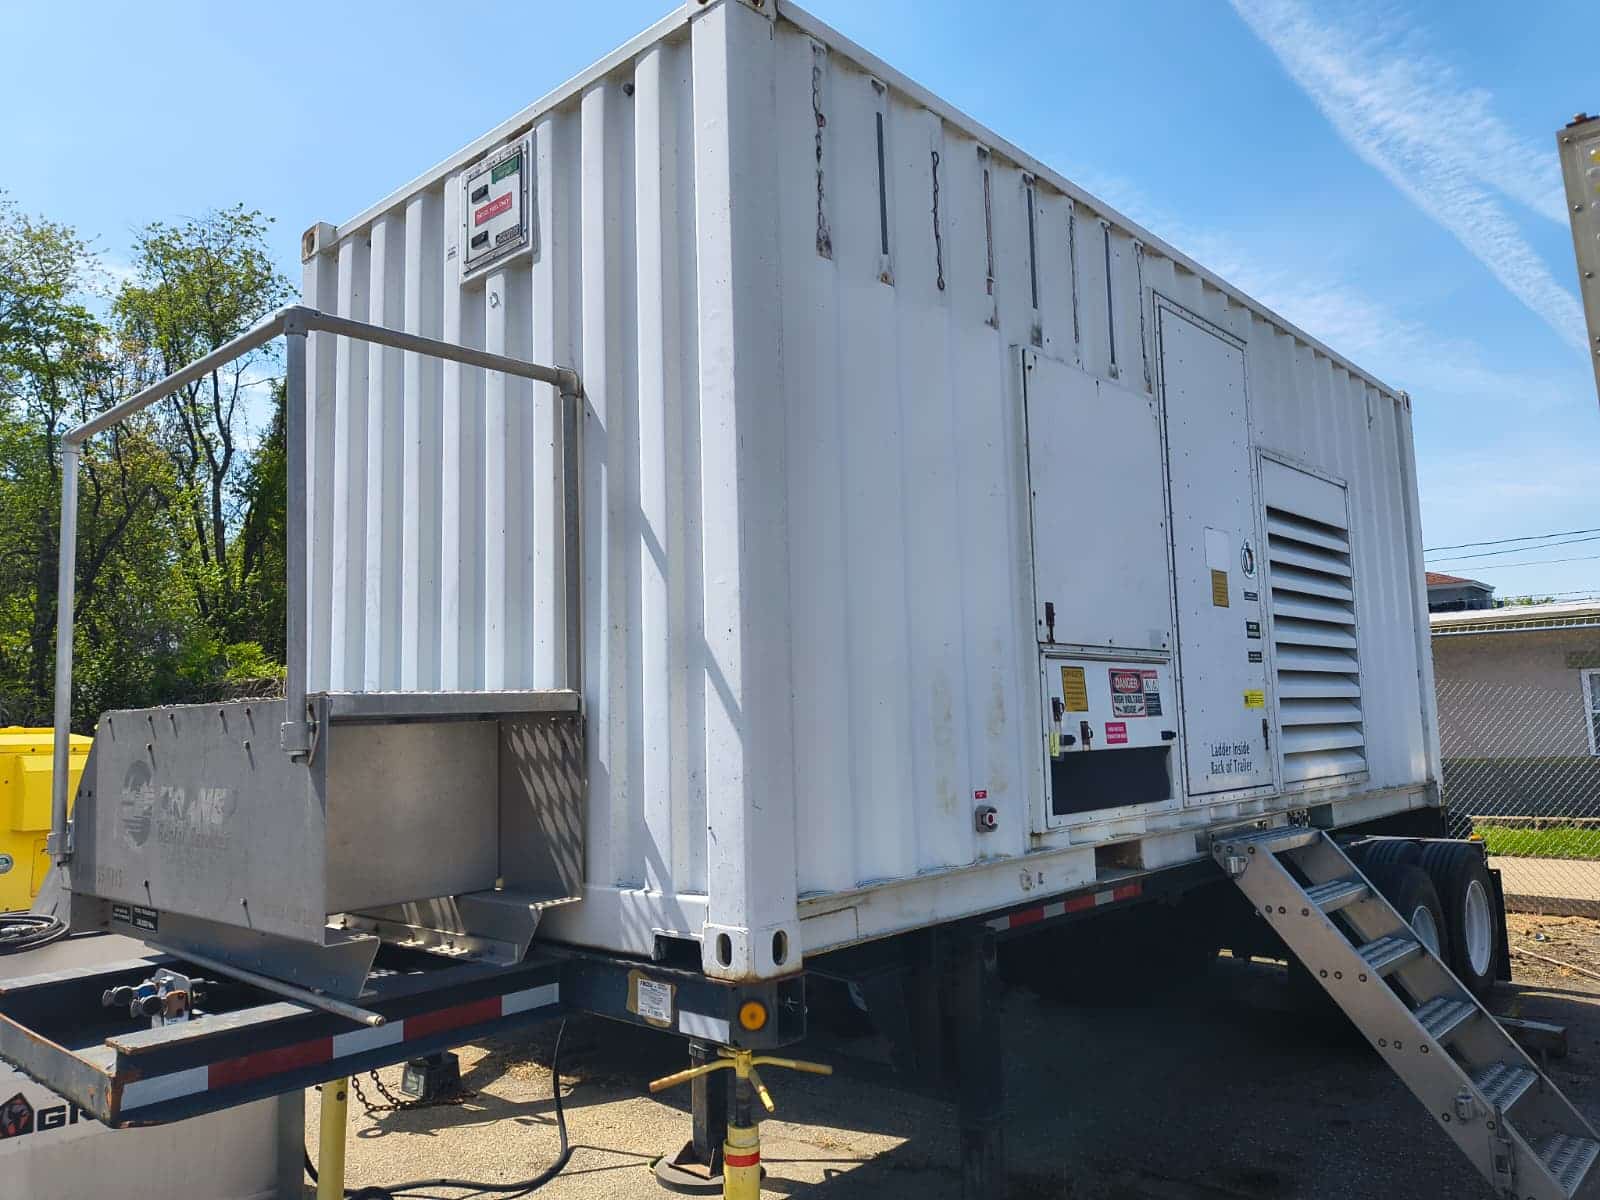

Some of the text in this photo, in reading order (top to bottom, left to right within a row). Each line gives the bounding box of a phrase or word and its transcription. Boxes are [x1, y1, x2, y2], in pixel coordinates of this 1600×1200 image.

[1114, 677, 1138, 689] DANGER
[1113, 695, 1125, 704] HIGH
[1125, 695, 1143, 704] VOLTAGE
[1122, 705, 1137, 714] INSIDE
[1211, 741, 1250, 757] Ladder Inside
[1211, 760, 1225, 774] Back
[1233, 758, 1252, 773] Trailer
